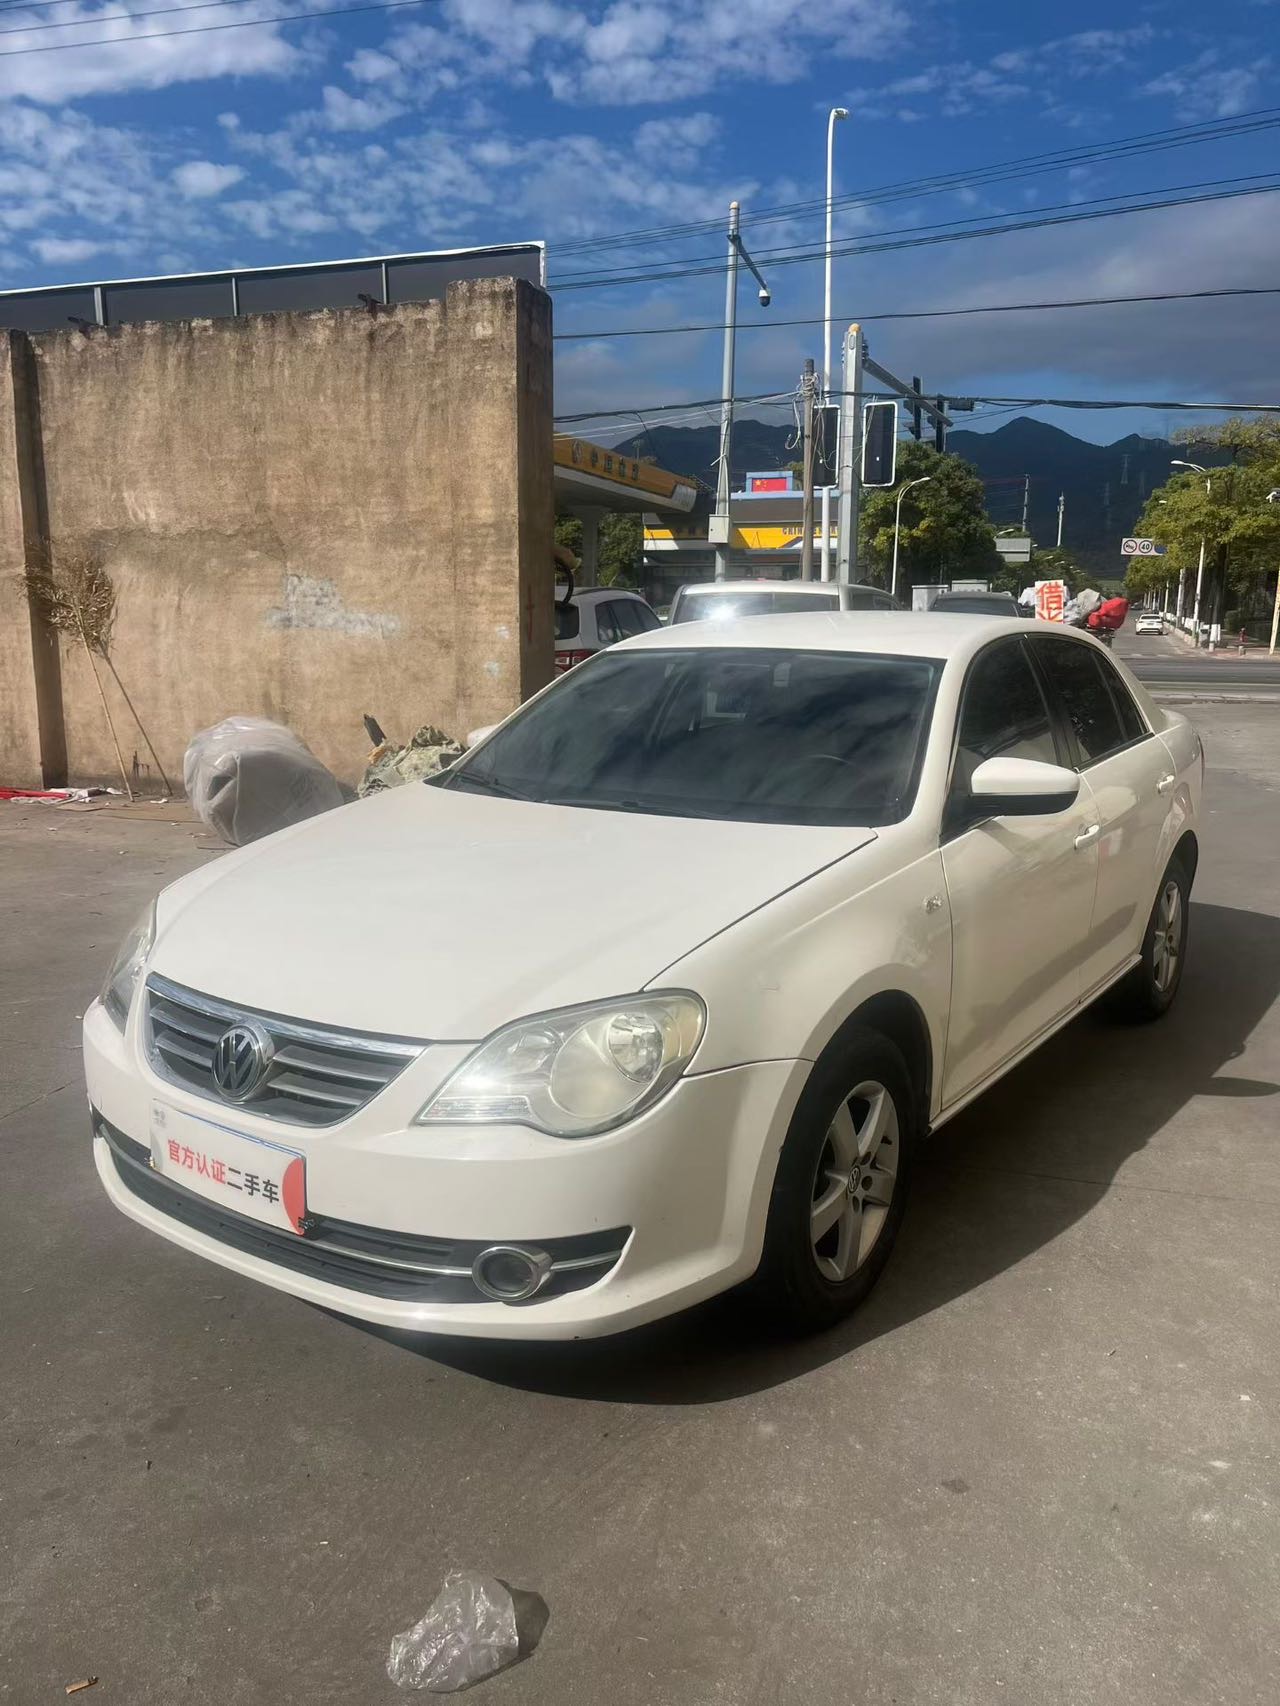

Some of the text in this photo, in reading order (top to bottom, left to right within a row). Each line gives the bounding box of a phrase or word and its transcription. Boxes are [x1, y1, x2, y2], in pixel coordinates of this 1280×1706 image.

[1141, 543, 1150, 551] 40
[168, 1139, 280, 1203] 官方认证二手车
